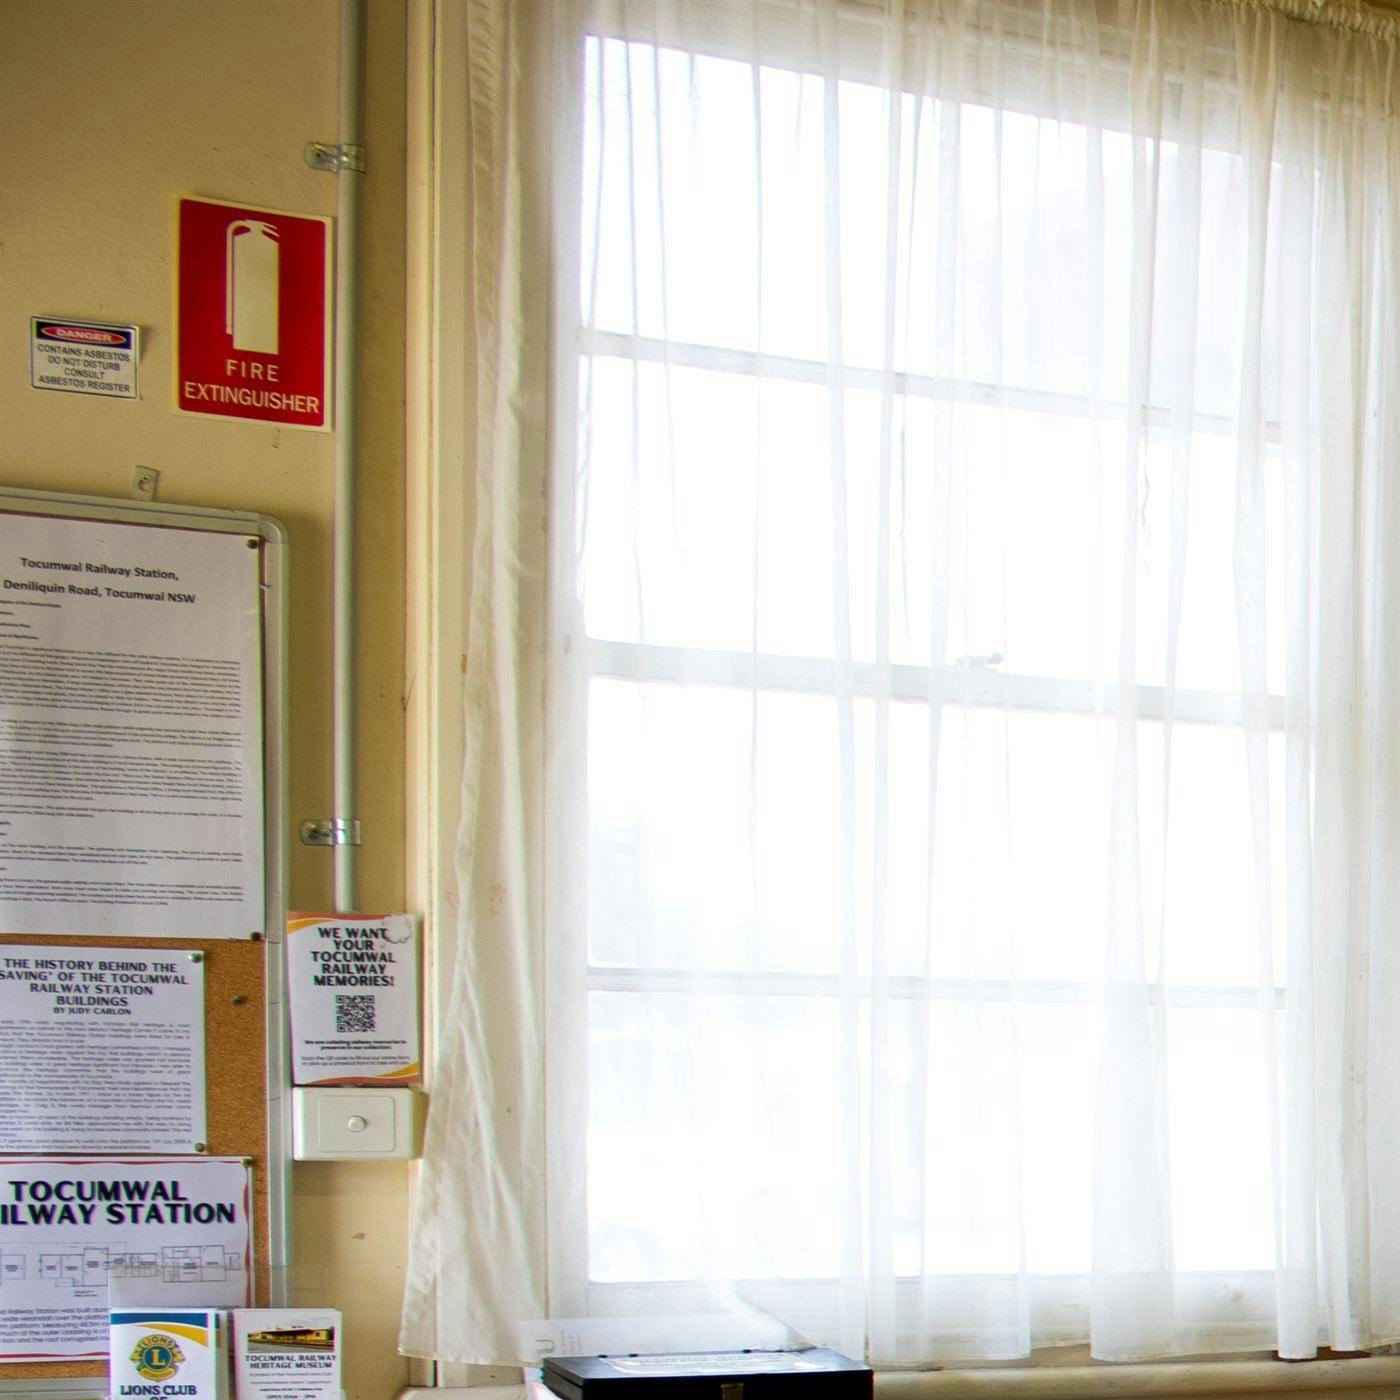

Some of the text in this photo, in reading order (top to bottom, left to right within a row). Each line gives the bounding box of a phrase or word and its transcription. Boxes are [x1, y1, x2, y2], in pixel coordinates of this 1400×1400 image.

[57, 327, 112, 342] DANGER
[37, 344, 130, 362] CONTAINS ASBESTOS
[48, 355, 120, 371] DO NOT DISTURB
[64, 367, 105, 379] CONSULT
[226, 360, 279, 383] FIRE
[39, 375, 129, 392] ASBESTOS REGISTER
[184, 381, 320, 414] EXTINGUISHER
[20, 557, 179, 581] Tocumwal Railway Station,
[3, 579, 196, 604] Deniliquin Road, Tocumwal NSW
[317, 927, 388, 939] WE WANT
[333, 939, 374, 950] YOUR
[311, 951, 397, 963] TOCUMWAL
[4, 958, 177, 973] THE HISTORY BEHIND THE
[321, 963, 387, 974] RAILWAY
[57, 971, 76, 982] OF
[80, 972, 107, 983] THE
[112, 973, 189, 985] TOCUMWAL
[313, 976, 395, 987] MEMORIES!
[30, 983, 154, 995] RAILWAY STATION
[56, 996, 129, 1007] BUILDINGS
[53, 1007, 132, 1016] BY JUDY CARLON
[8, 1180, 188, 1202] TOCUMWAL
[0, 1203, 236, 1225] ILWAY STATION
[142, 1336, 172, 1347] LIONS
[152, 1349, 166, 1366] L
[245, 1355, 296, 1363] TOCUMWAL
[250, 1362, 293, 1370] HERITAGE
[120, 1385, 197, 1396] LIONS CLUB
